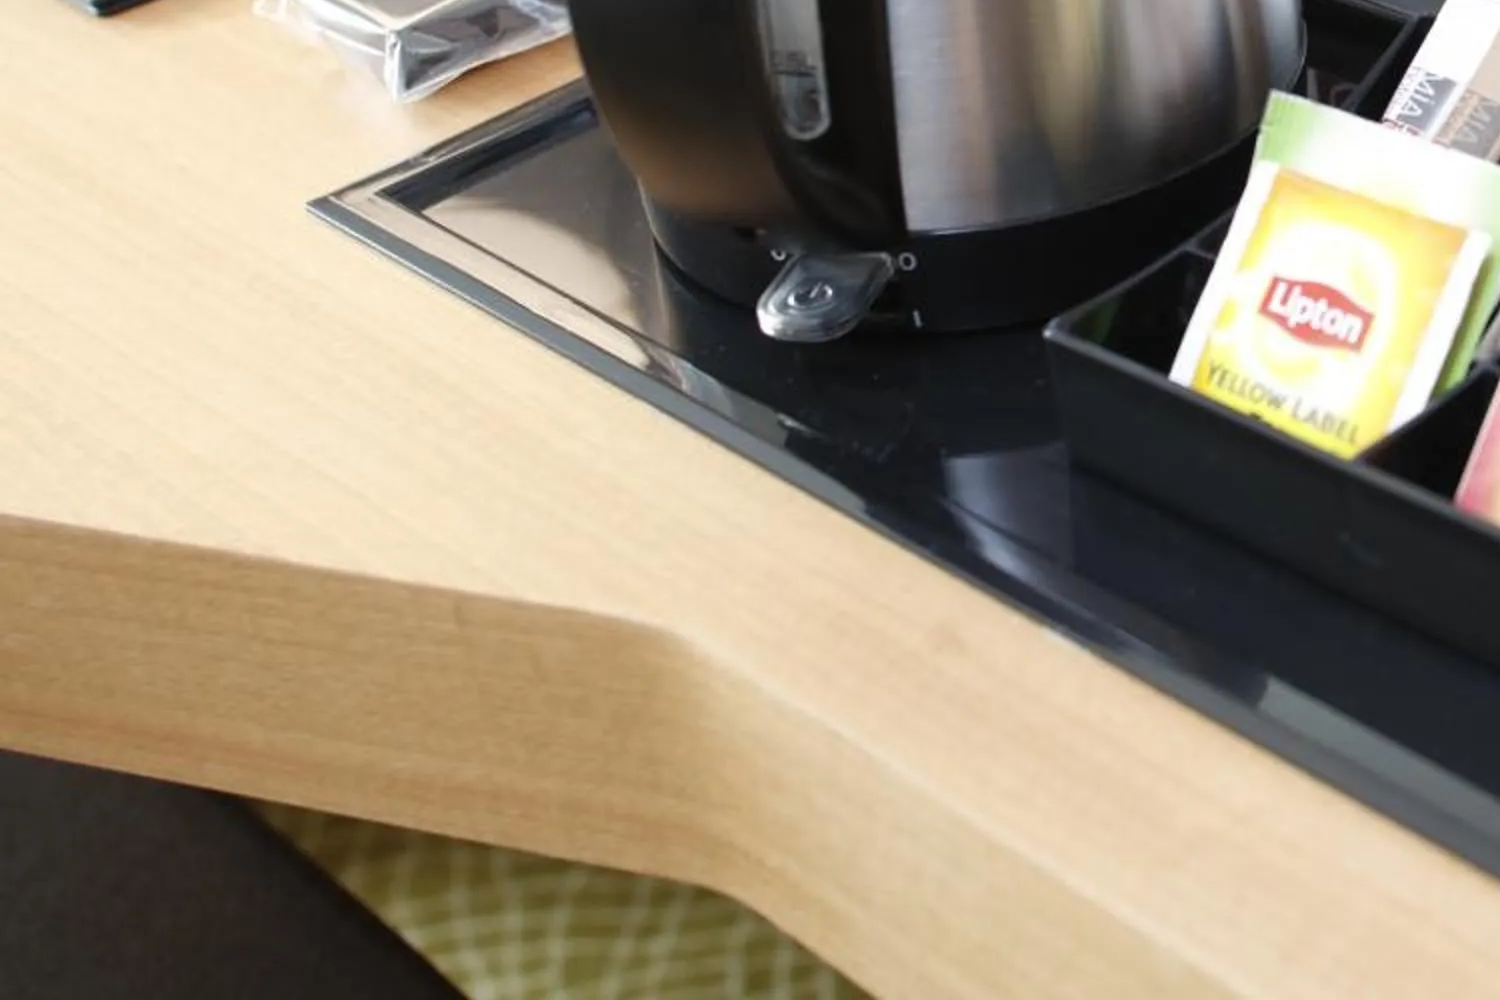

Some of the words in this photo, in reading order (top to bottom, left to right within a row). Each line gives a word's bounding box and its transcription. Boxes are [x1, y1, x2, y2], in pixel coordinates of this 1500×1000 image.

[1267, 281, 1364, 345] Lipton
[1208, 359, 1287, 410] YELLOW
[1291, 396, 1360, 446] LABEL
